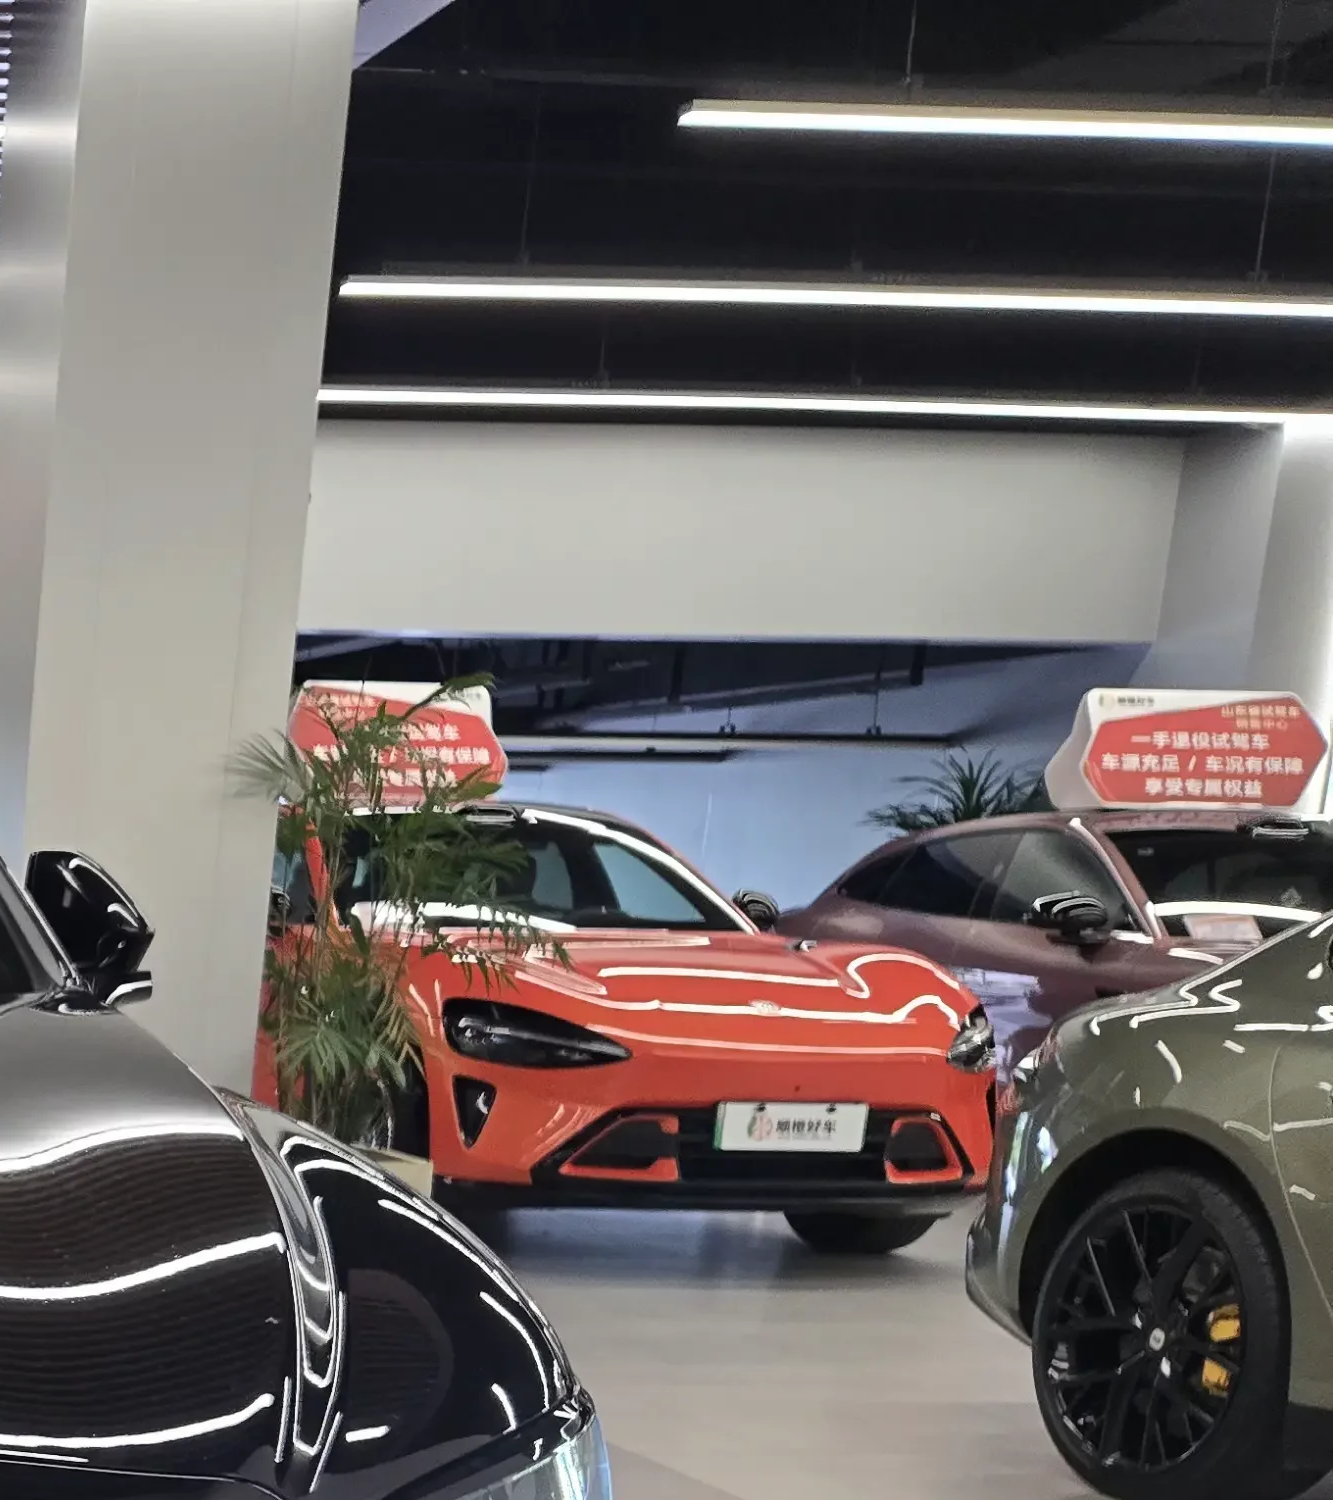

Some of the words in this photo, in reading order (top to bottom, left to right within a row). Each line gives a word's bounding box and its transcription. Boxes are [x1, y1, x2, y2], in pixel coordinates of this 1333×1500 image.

[1131, 731, 1270, 750] 一手退役试驾车
[1102, 753, 1180, 772] 车源充足
[1205, 755, 1304, 775] 车况有保障
[1145, 777, 1263, 798] 享受专属权益
